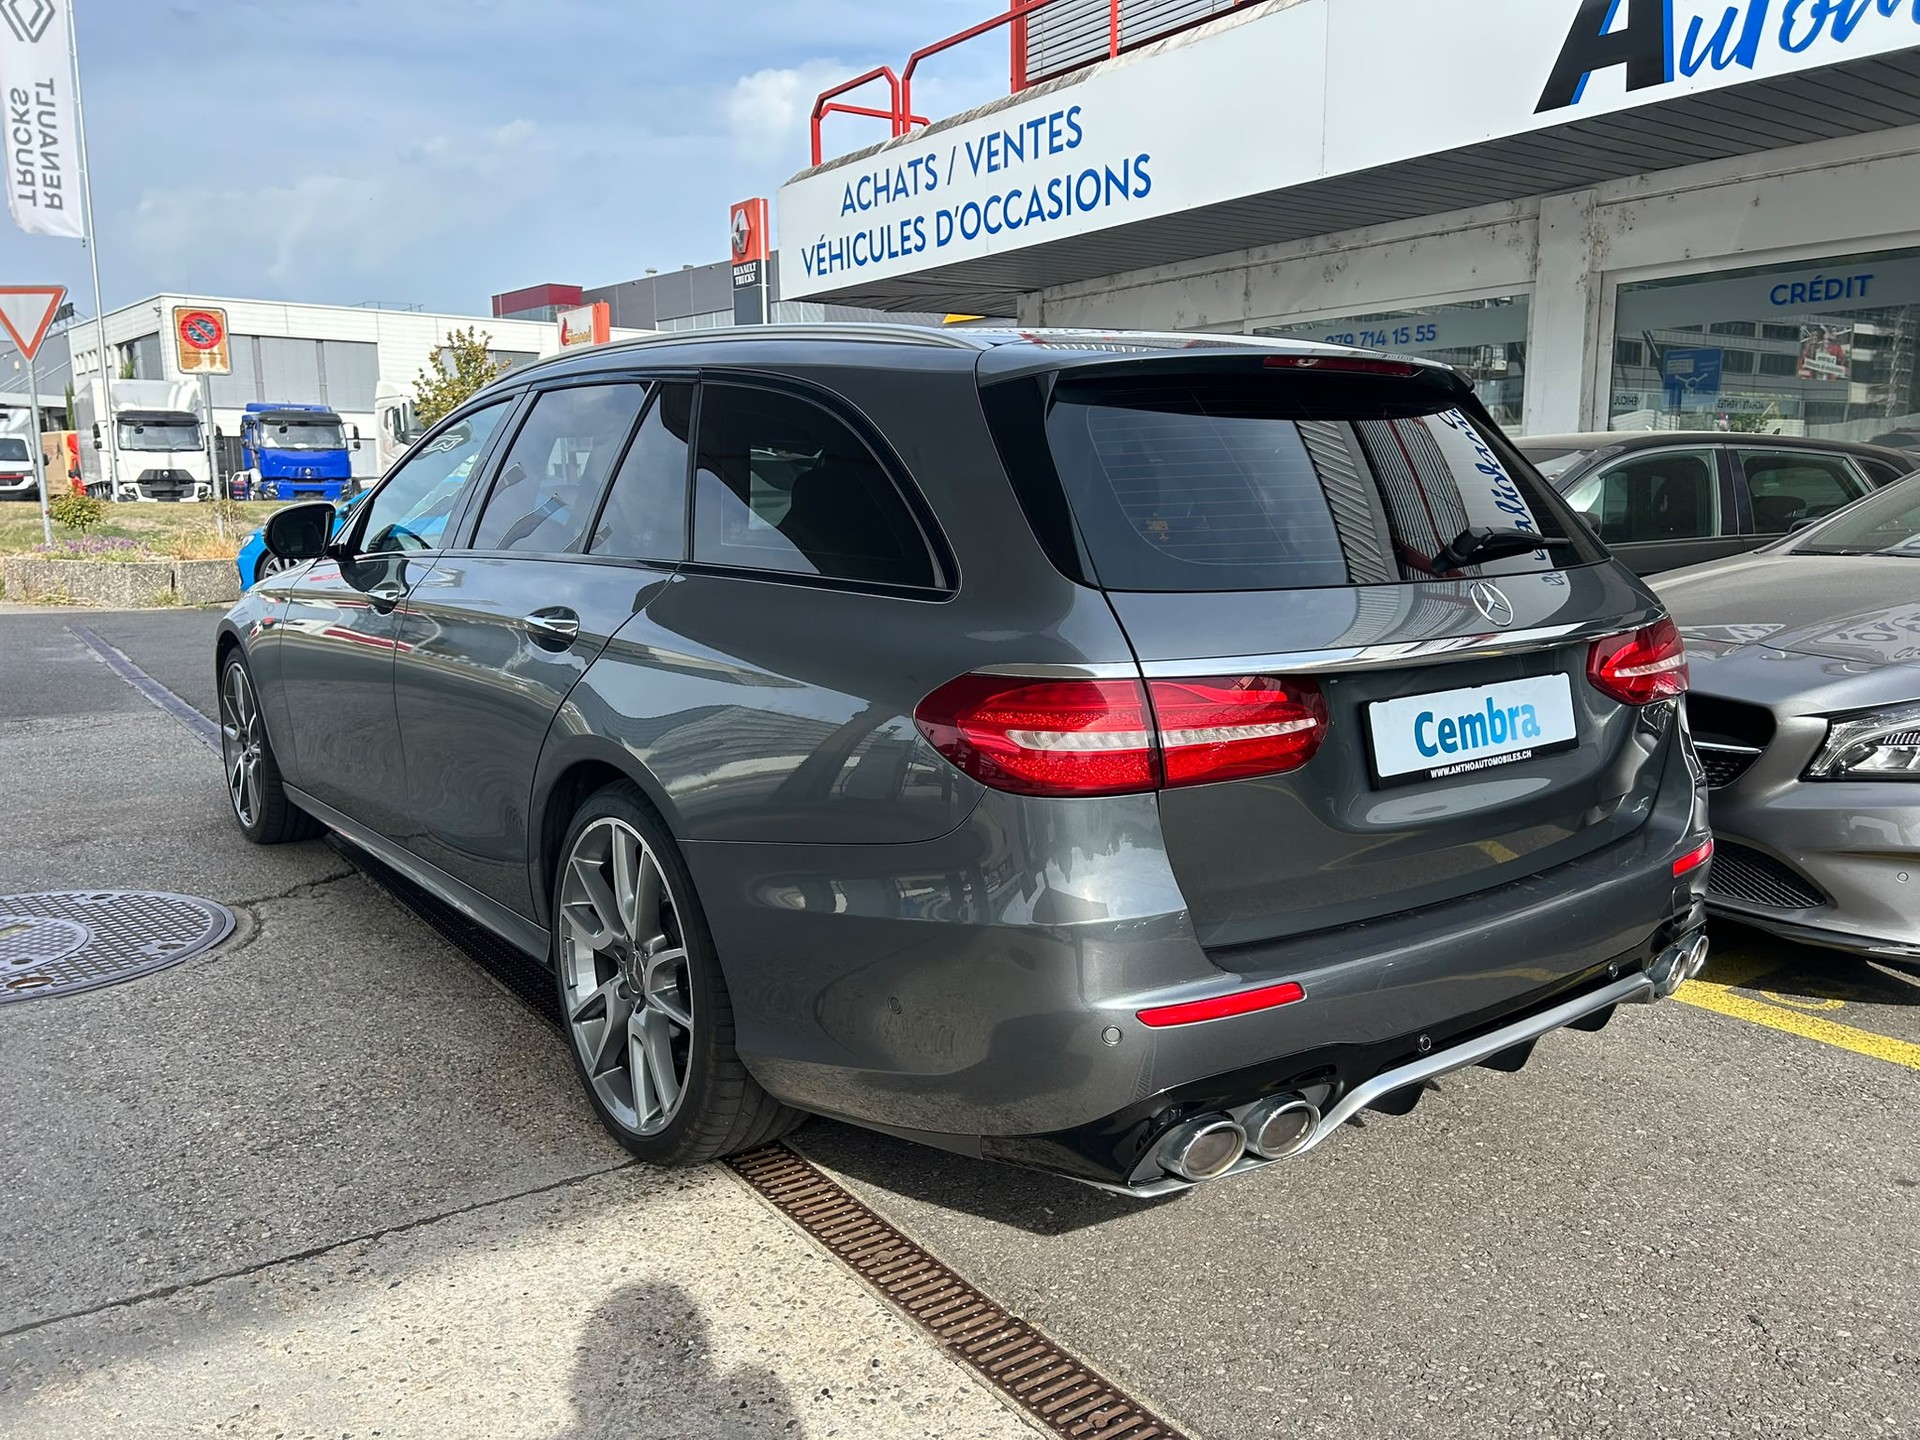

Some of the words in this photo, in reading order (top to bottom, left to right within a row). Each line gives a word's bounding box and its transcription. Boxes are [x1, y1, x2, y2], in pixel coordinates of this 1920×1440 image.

[841, 153, 937, 217] ACHATS
[947, 145, 956, 185] /
[966, 105, 1083, 177] VENTES
[801, 215, 926, 278] VÉHICULES
[936, 153, 1152, 248] D'OCCASIONS
[1769, 274, 1874, 306] CRÉDIT
[1359, 329, 1386, 347] 714
[1393, 327, 1410, 344] 15
[1415, 324, 1436, 342] 55
[1414, 697, 1541, 758] Cembra
[1430, 750, 1532, 778] WWW.ANTHOAUTOMOBILES.CH
